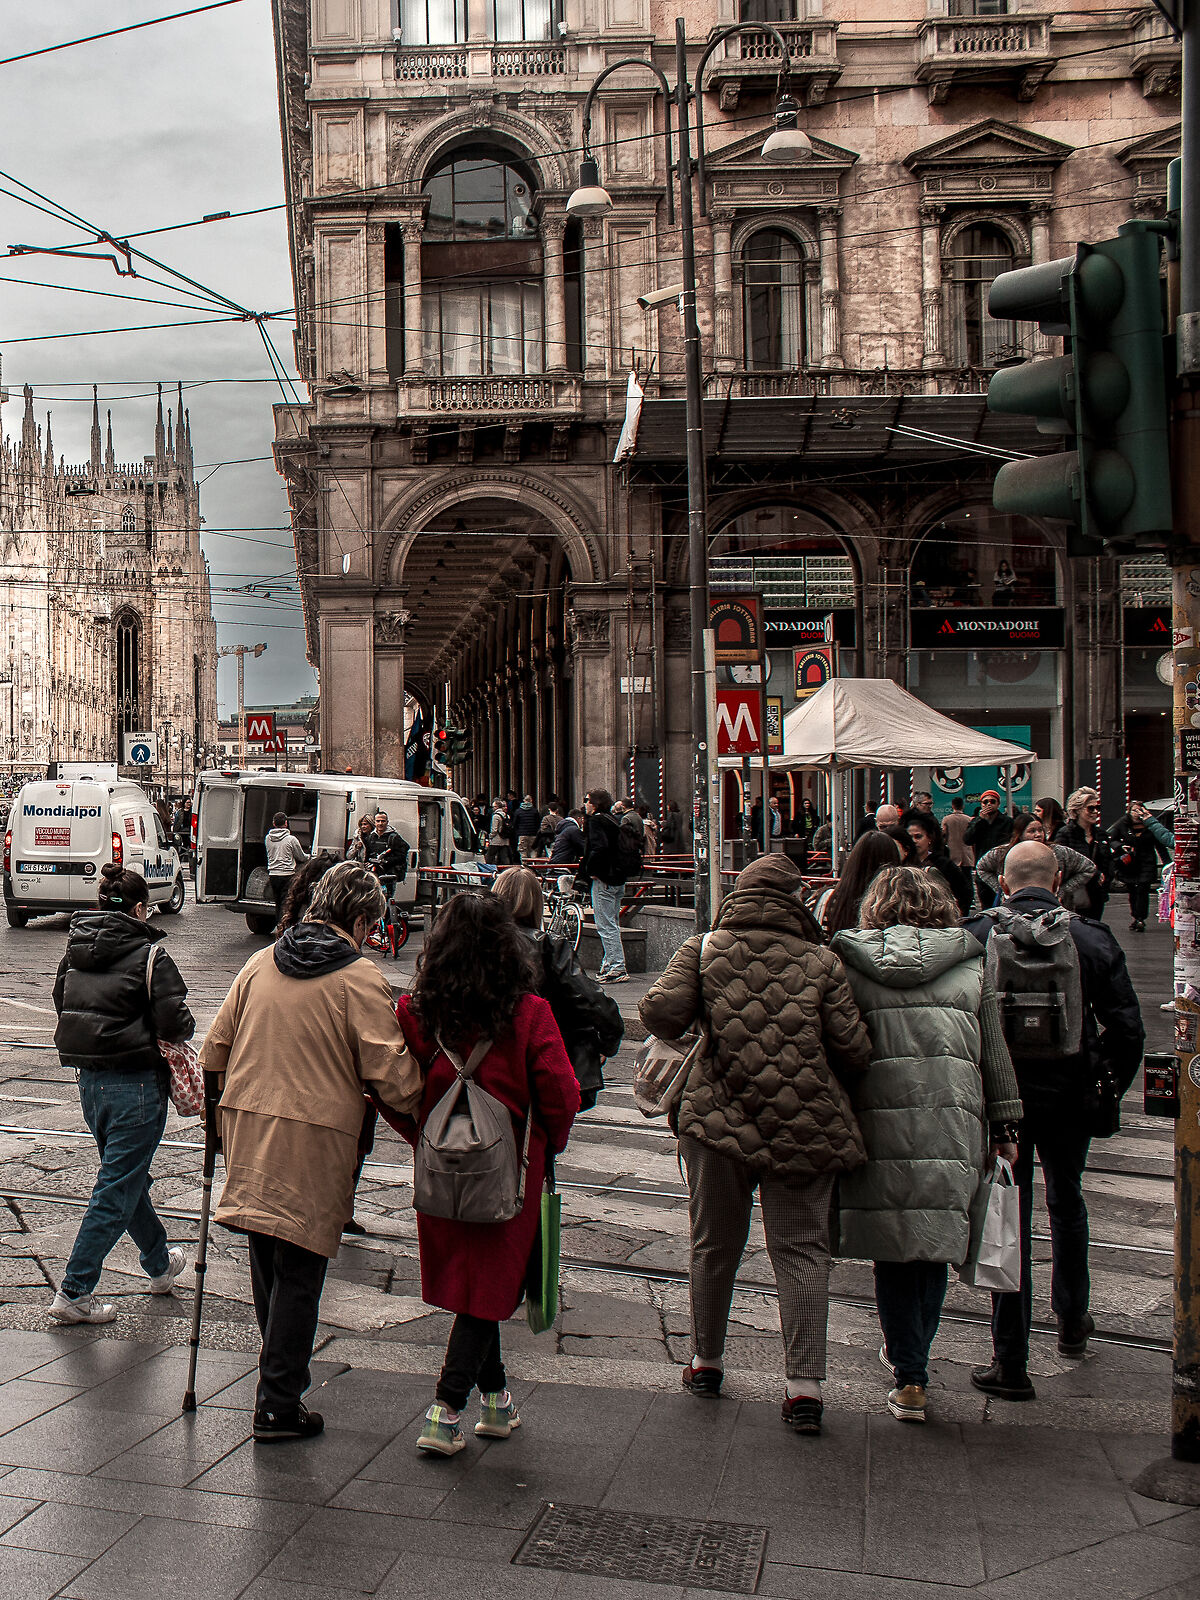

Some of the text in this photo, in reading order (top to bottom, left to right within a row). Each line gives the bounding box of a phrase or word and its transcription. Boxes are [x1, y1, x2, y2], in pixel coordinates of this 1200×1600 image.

[763, 621, 824, 631] ONDADOR
[956, 620, 1040, 631] MONDADORI
[800, 631, 824, 639] DUOM
[1009, 631, 1040, 639] DUOMO
[249, 719, 271, 736] M
[716, 702, 758, 741] M
[23, 804, 102, 819] Mondialpol
[144, 854, 174, 880] Mondialpol
